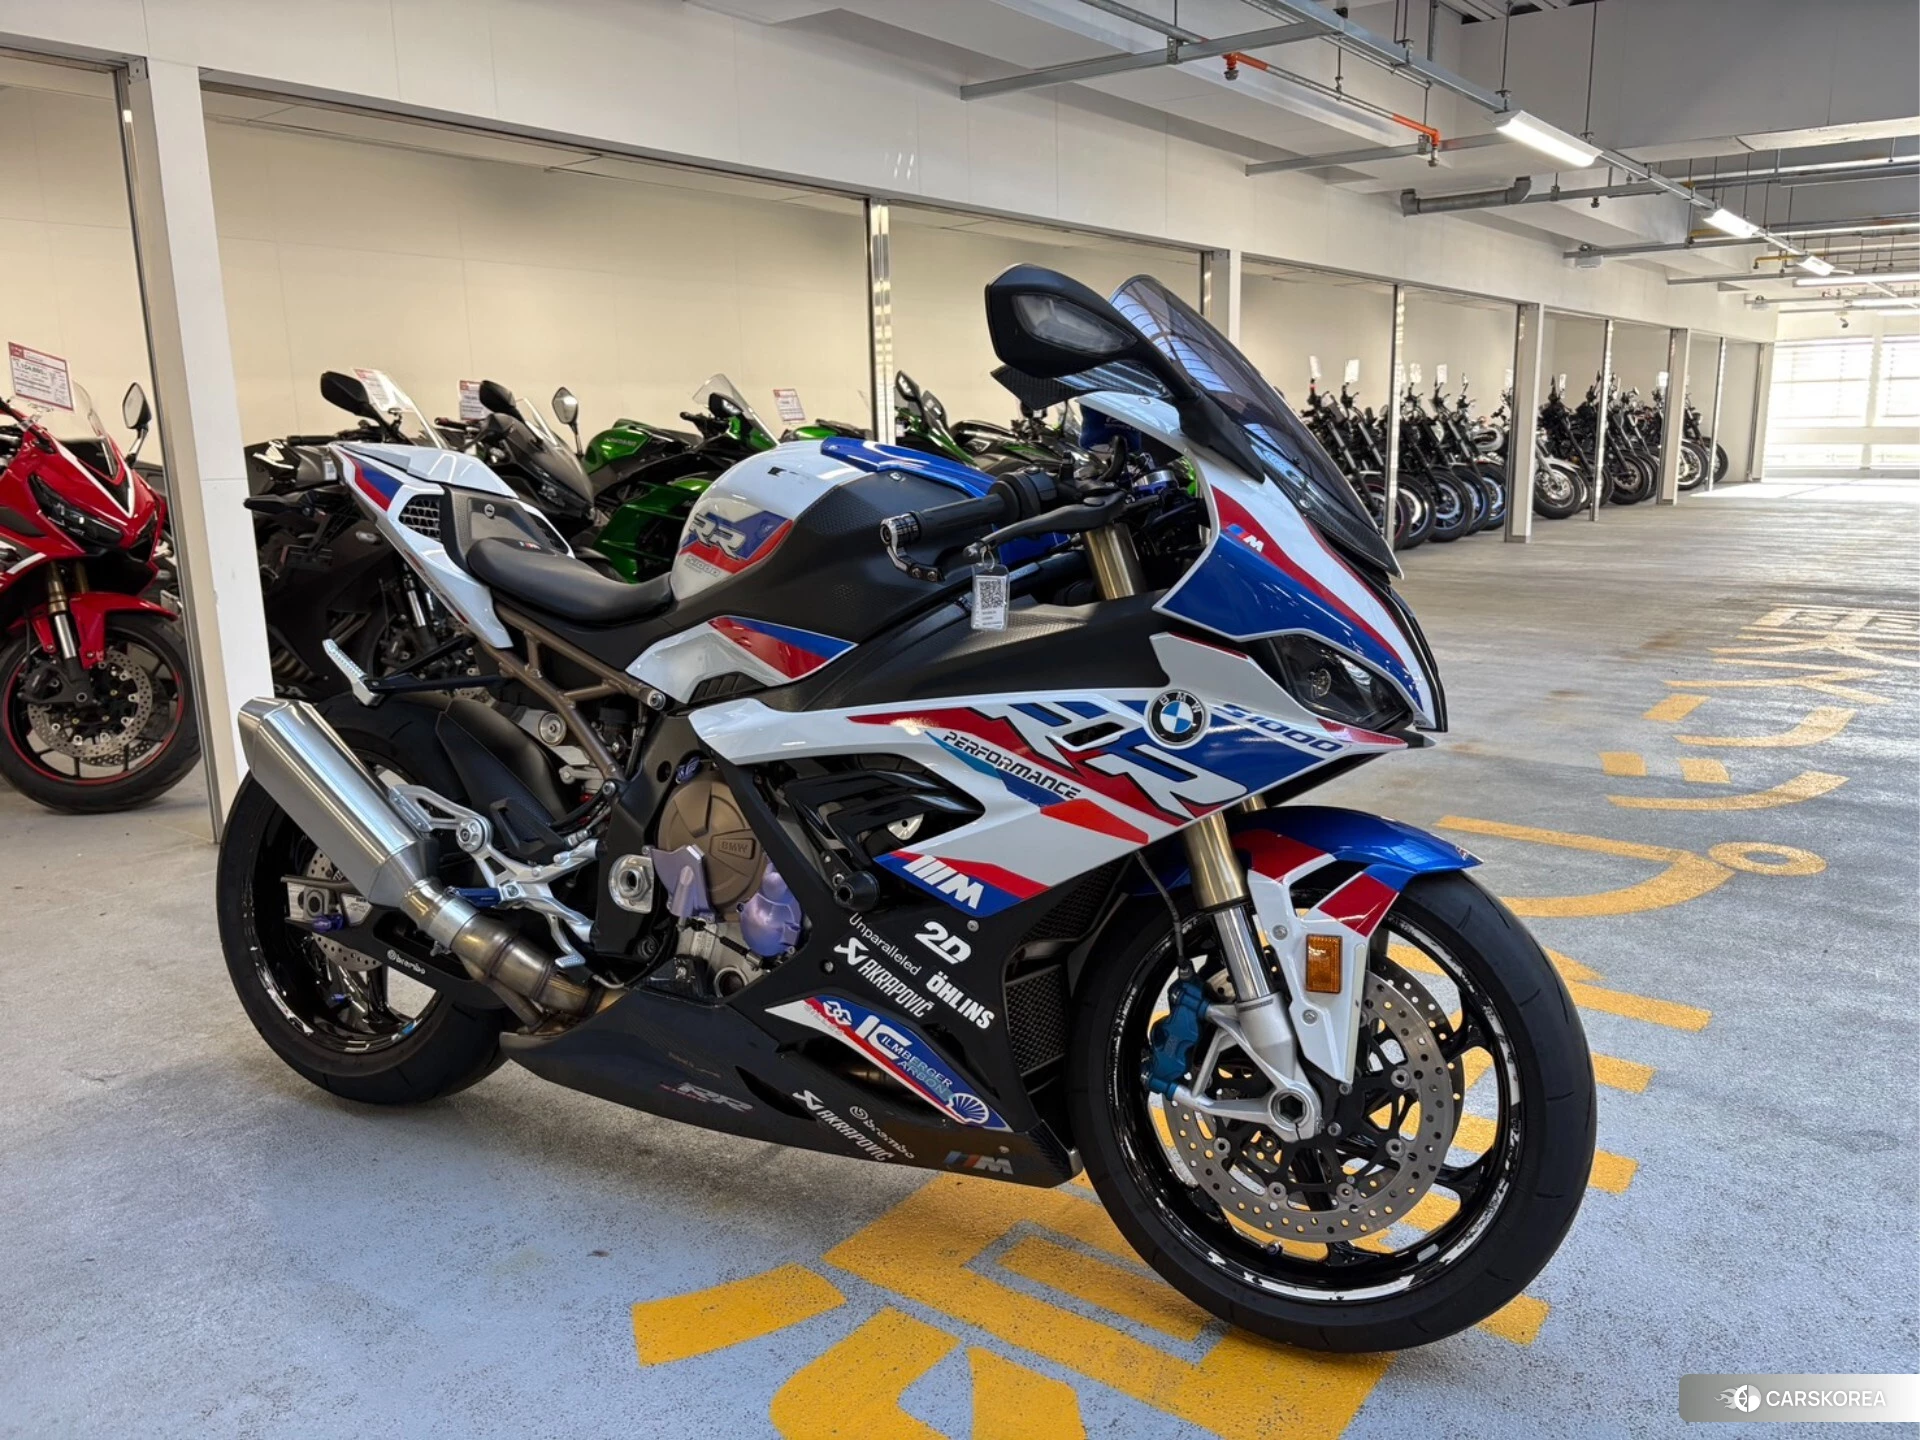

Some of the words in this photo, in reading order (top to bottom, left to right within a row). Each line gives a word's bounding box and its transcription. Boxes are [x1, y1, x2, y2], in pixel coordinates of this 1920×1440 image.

[1213, 703, 1344, 753] S1000
[943, 731, 1081, 799] PERFORMANCE
[721, 841, 750, 853] BMW
[849, 912, 922, 976] Unparalleled
[914, 921, 972, 965] 2D
[926, 971, 995, 1029] ÖHLINS
[880, 1036, 953, 1088] ILMBERGER
[863, 1117, 916, 1160] brembo
